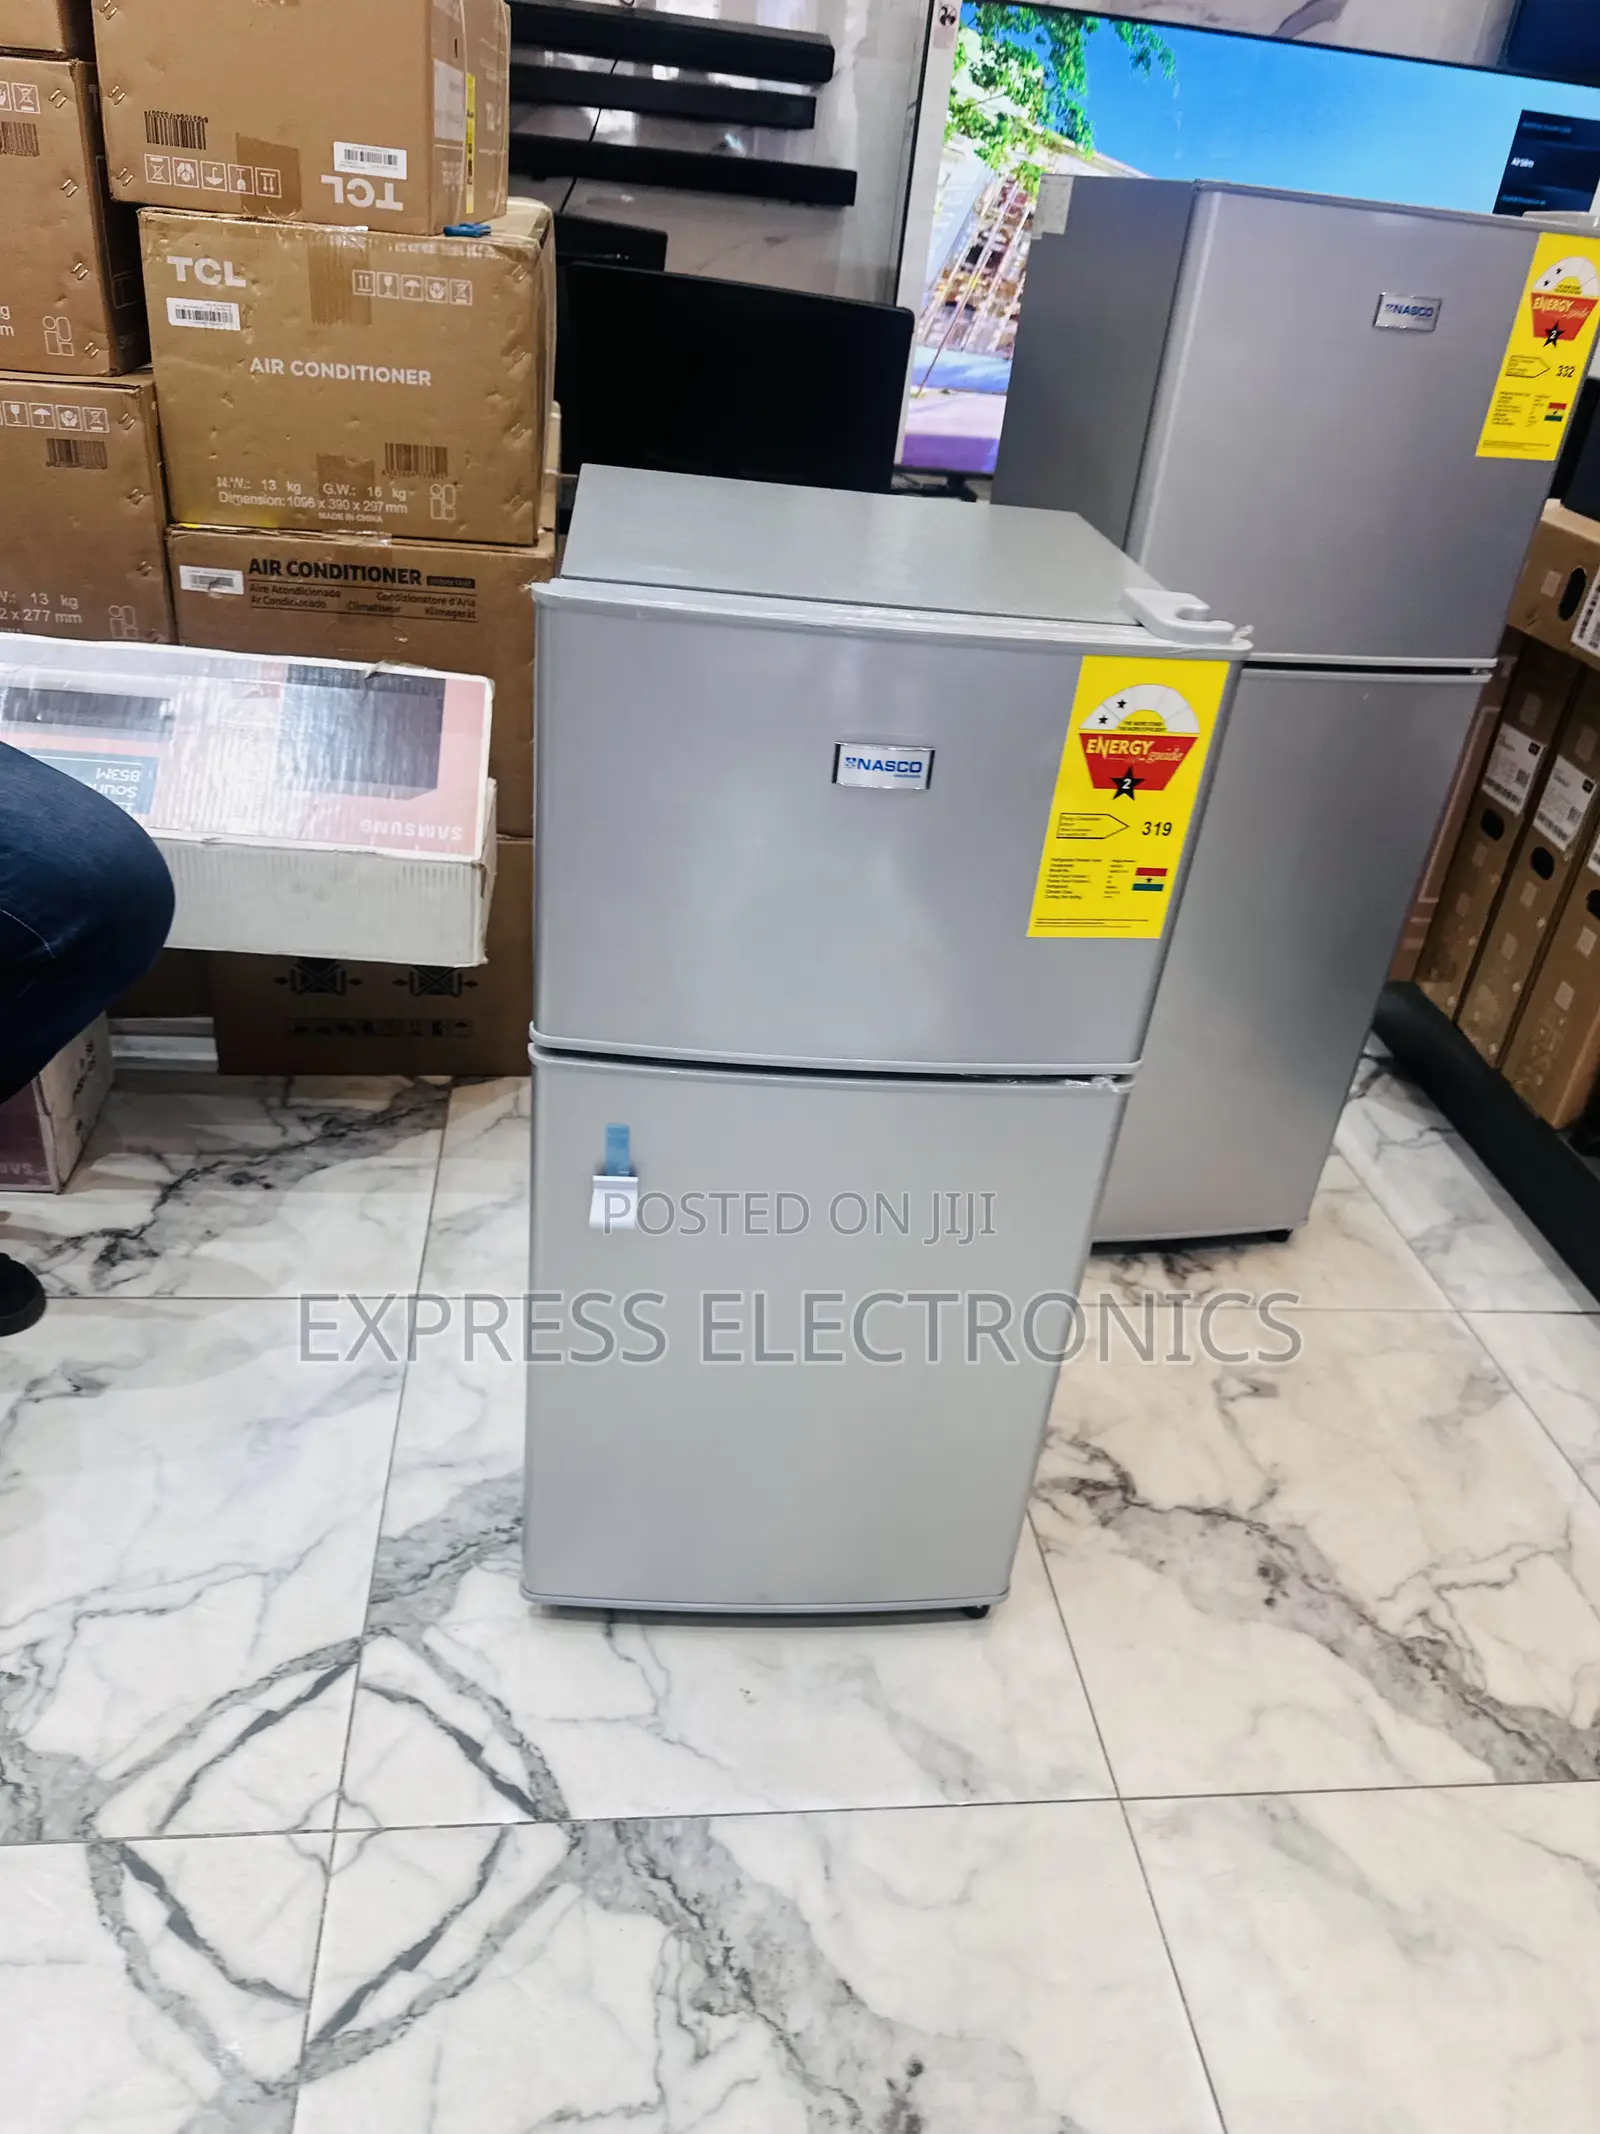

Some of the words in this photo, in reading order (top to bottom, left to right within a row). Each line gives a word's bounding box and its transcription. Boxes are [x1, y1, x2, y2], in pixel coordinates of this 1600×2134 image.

[321, 175, 403, 210] TCL
[167, 255, 246, 287] TCL
[1394, 304, 1433, 317] NASCO
[250, 357, 284, 375] AIR
[290, 360, 431, 386] CONDITIONER
[1556, 365, 1575, 378] 332
[261, 479, 277, 491] 13
[286, 480, 301, 495] kg
[323, 483, 356, 497] G.W.:
[392, 488, 407, 502] kg
[319, 501, 326, 510] x
[353, 502, 360, 511] x
[248, 558, 282, 577] AIR
[286, 558, 422, 586] CONDITIONER
[30, 592, 49, 605] 13
[60, 594, 78, 610] kg
[11, 610, 20, 620] x
[23, 608, 51, 622] 277
[1086, 736, 1155, 759] ENERGY
[857, 758, 922, 773] NASCO
[85, 782, 138, 798] Soun
[1122, 778, 1132, 789] 2
[360, 819, 462, 841] SAMSUNG
[1141, 821, 1173, 836] 319
